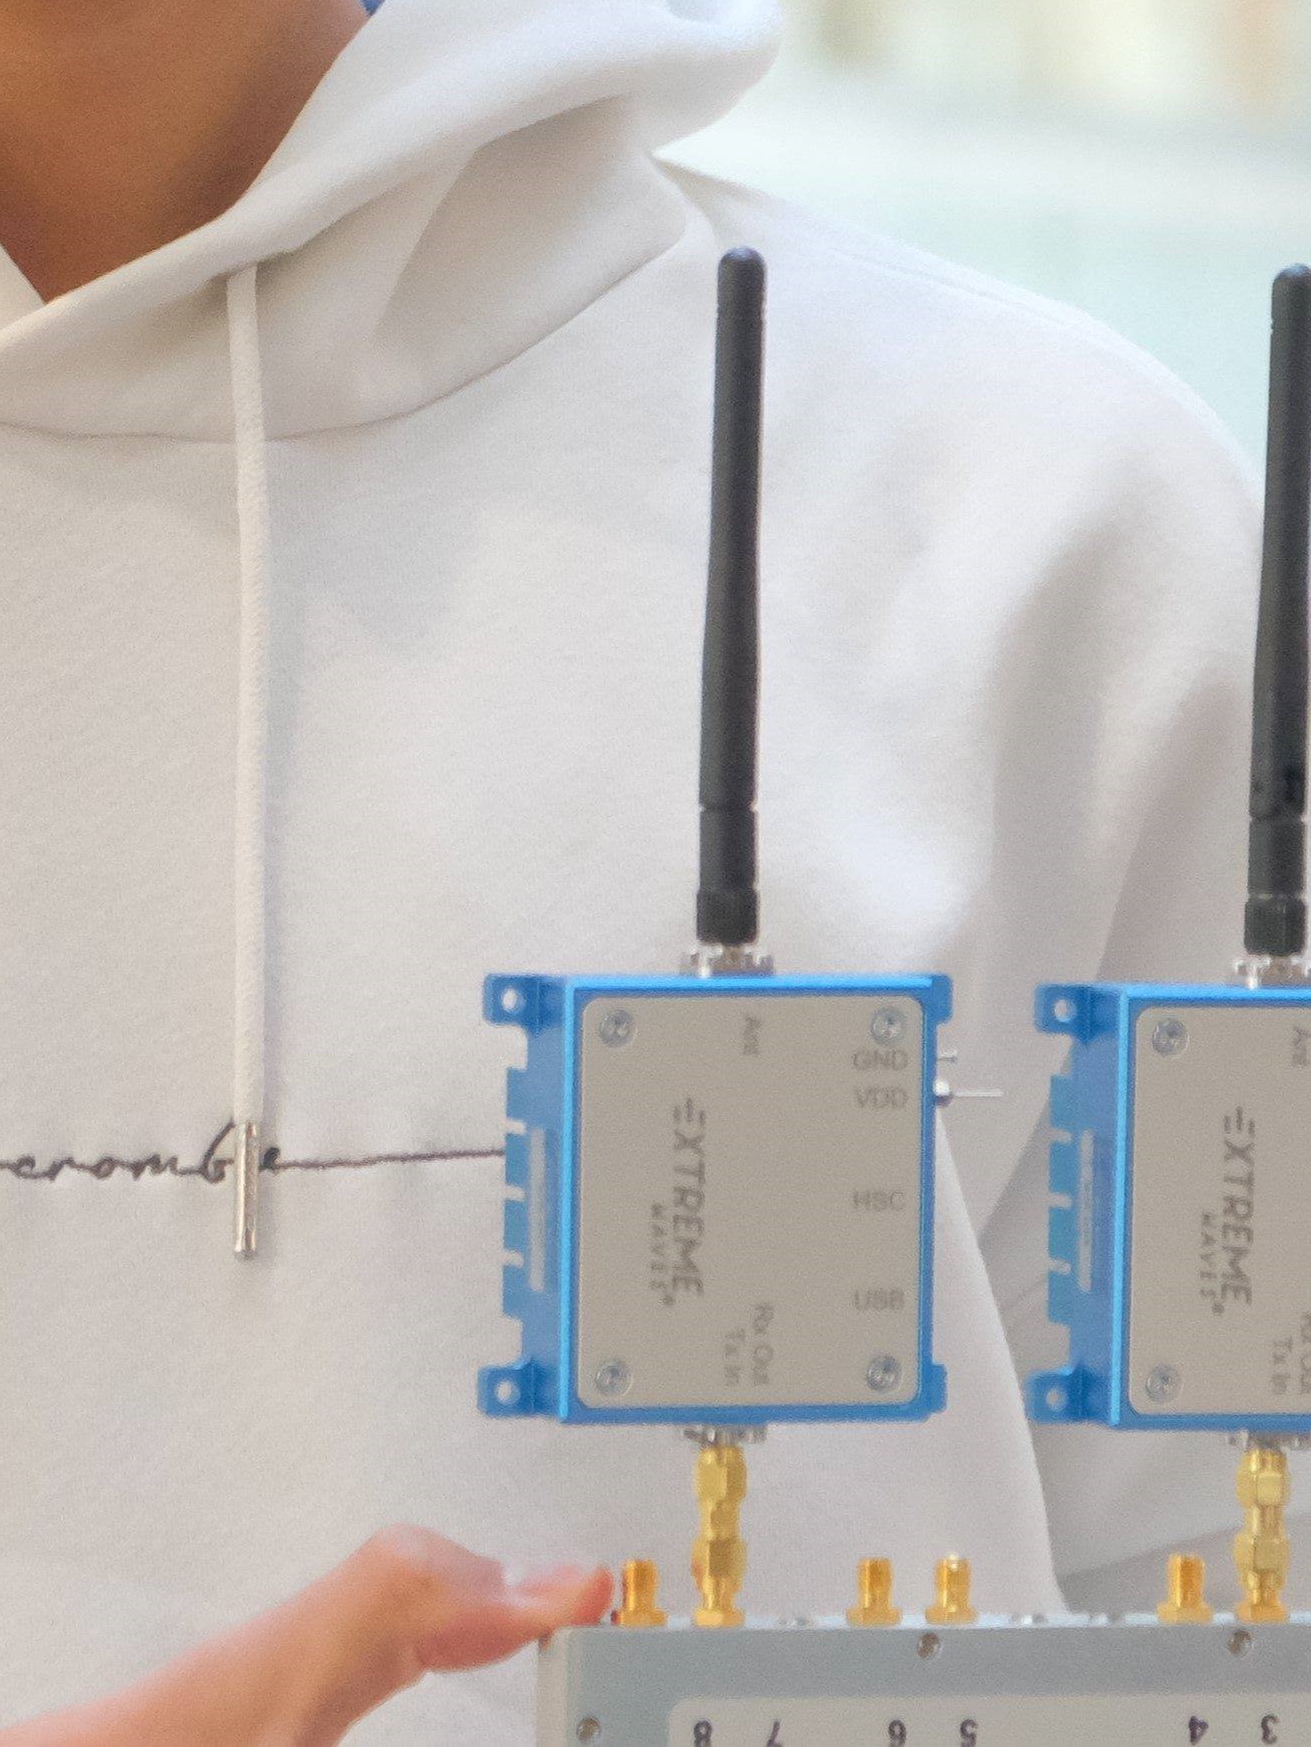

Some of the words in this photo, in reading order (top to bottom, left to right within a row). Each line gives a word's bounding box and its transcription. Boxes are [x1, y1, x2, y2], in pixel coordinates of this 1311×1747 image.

[852, 1049, 909, 1072] GND
[853, 1086, 908, 1109] VDD
[671, 1097, 706, 1296] EXTREME
[852, 1189, 906, 1212] HSC
[1220, 1106, 1256, 1306] EXTREME
[693, 1719, 713, 1747] 8
[887, 1718, 907, 1747] 6
[958, 1717, 979, 1747] 5
[1188, 1714, 1209, 1746] 4
[1259, 1713, 1279, 1745] 3
